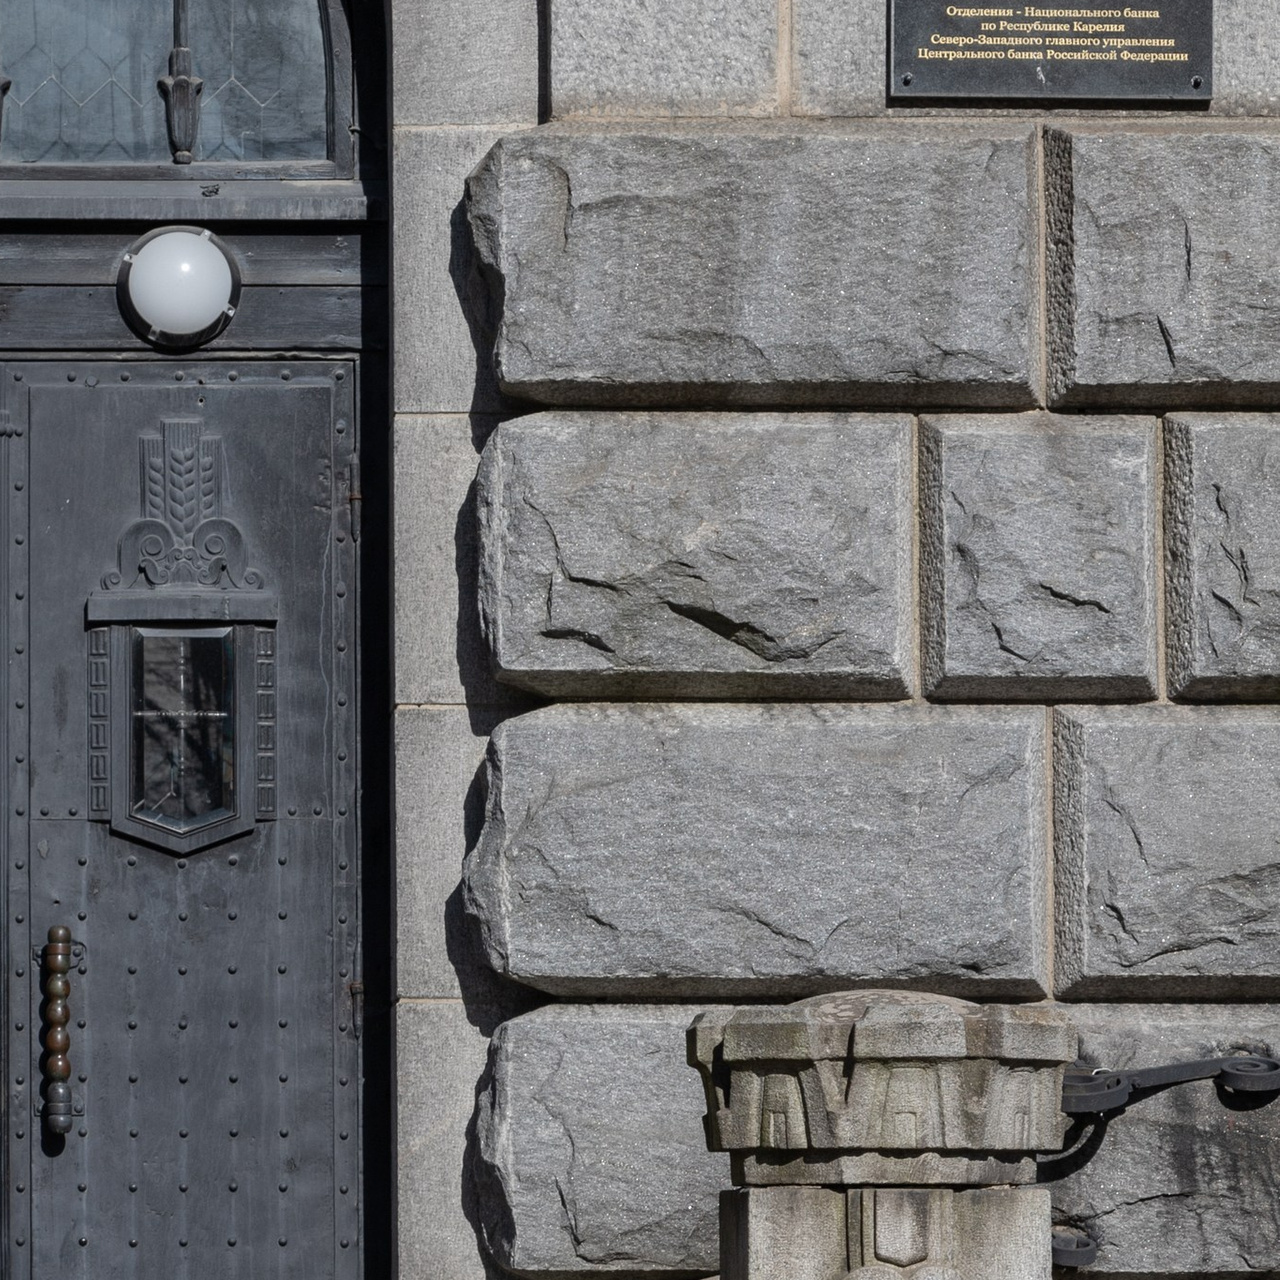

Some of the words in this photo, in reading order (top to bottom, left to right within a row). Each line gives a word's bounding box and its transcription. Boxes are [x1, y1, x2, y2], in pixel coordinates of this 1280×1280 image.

[946, 5, 1014, 18] Отделения
[1024, 6, 1122, 19] Национального
[1123, 7, 1160, 19] банка
[980, 22, 997, 32] по
[999, 20, 1071, 33] Республике
[1073, 21, 1126, 34] Карелия
[930, 33, 1043, 47] Северо-Западного
[1045, 37, 1101, 47] главного
[1102, 38, 1175, 48] управления
[917, 47, 1006, 61] Центрального
[1007, 48, 1044, 61] банка
[1046, 48, 1118, 61] Российской
[1119, 51, 1189, 63] Федерации
